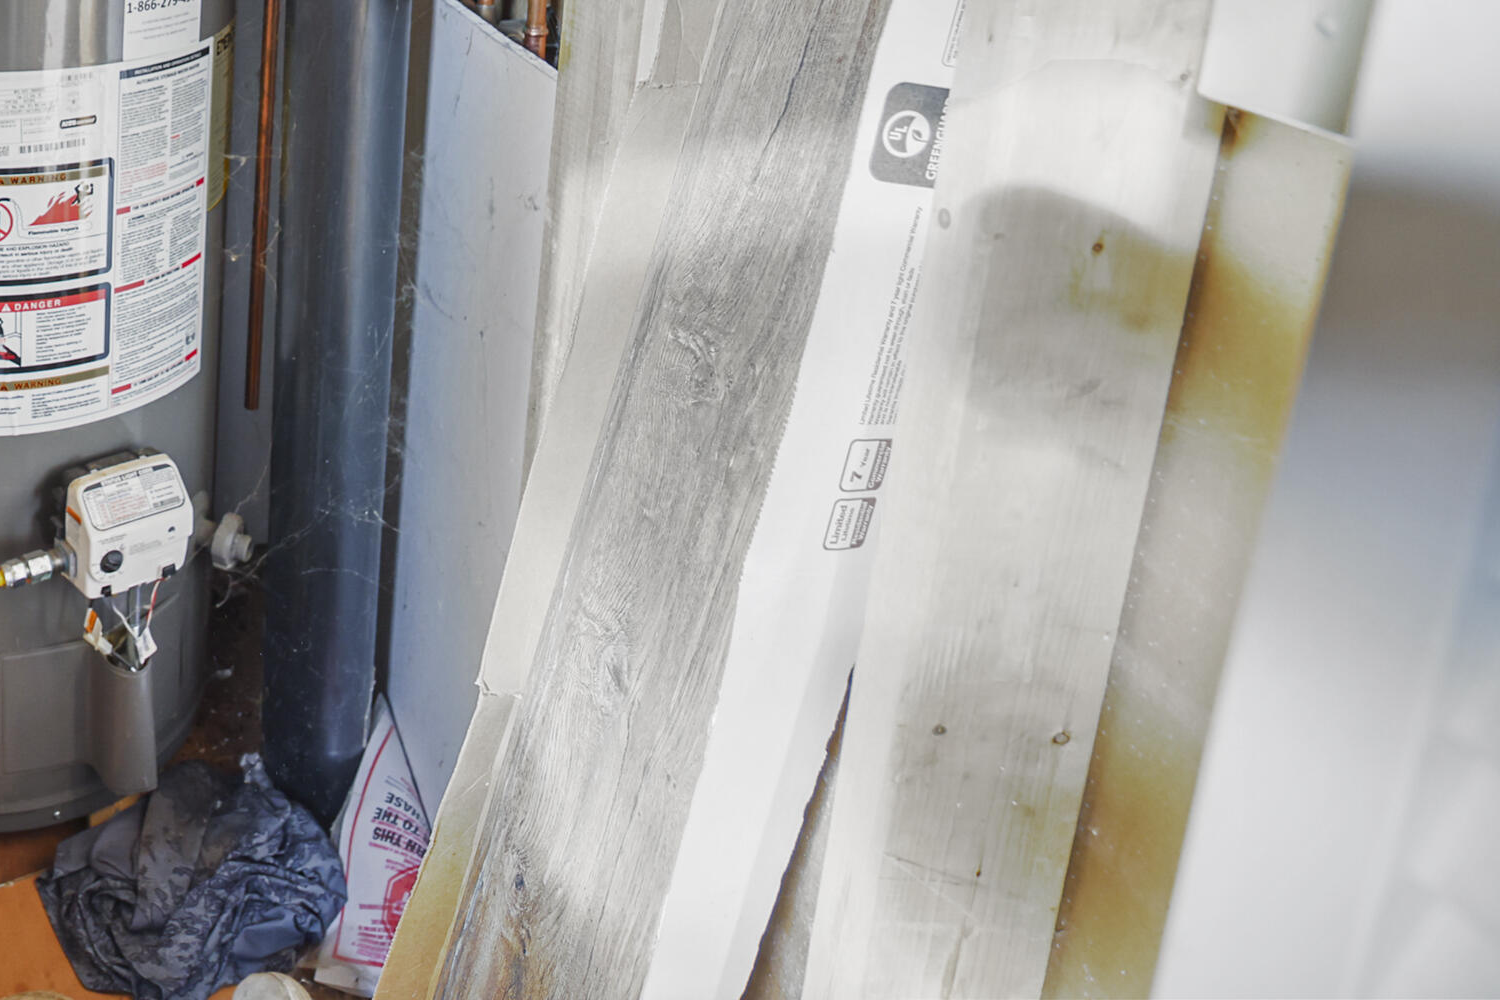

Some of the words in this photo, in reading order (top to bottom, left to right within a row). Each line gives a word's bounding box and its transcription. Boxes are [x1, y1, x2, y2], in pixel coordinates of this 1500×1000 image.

[888, 125, 908, 141] UL
[10, 173, 67, 185] WARNING
[14, 299, 61, 311] DANGER
[14, 378, 61, 390] WARNING
[849, 470, 862, 482] 7
[829, 504, 847, 544] Limited
